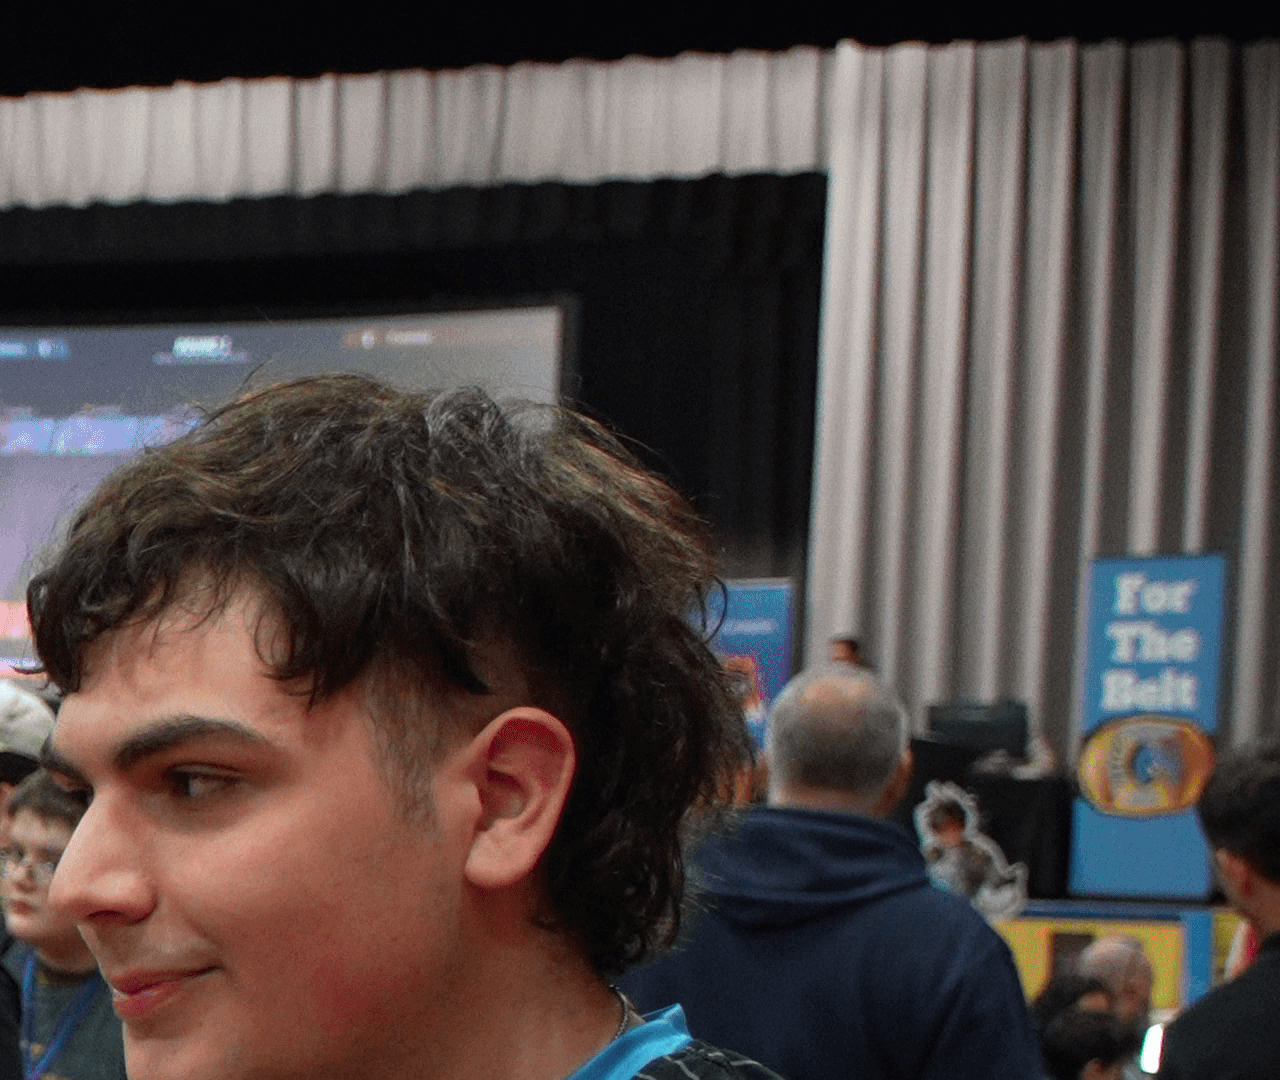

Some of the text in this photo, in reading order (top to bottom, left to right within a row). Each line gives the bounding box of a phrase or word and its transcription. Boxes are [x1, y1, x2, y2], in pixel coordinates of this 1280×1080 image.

[1114, 571, 1197, 614] For
[1105, 621, 1198, 663] The
[1102, 667, 1197, 711] Belt
